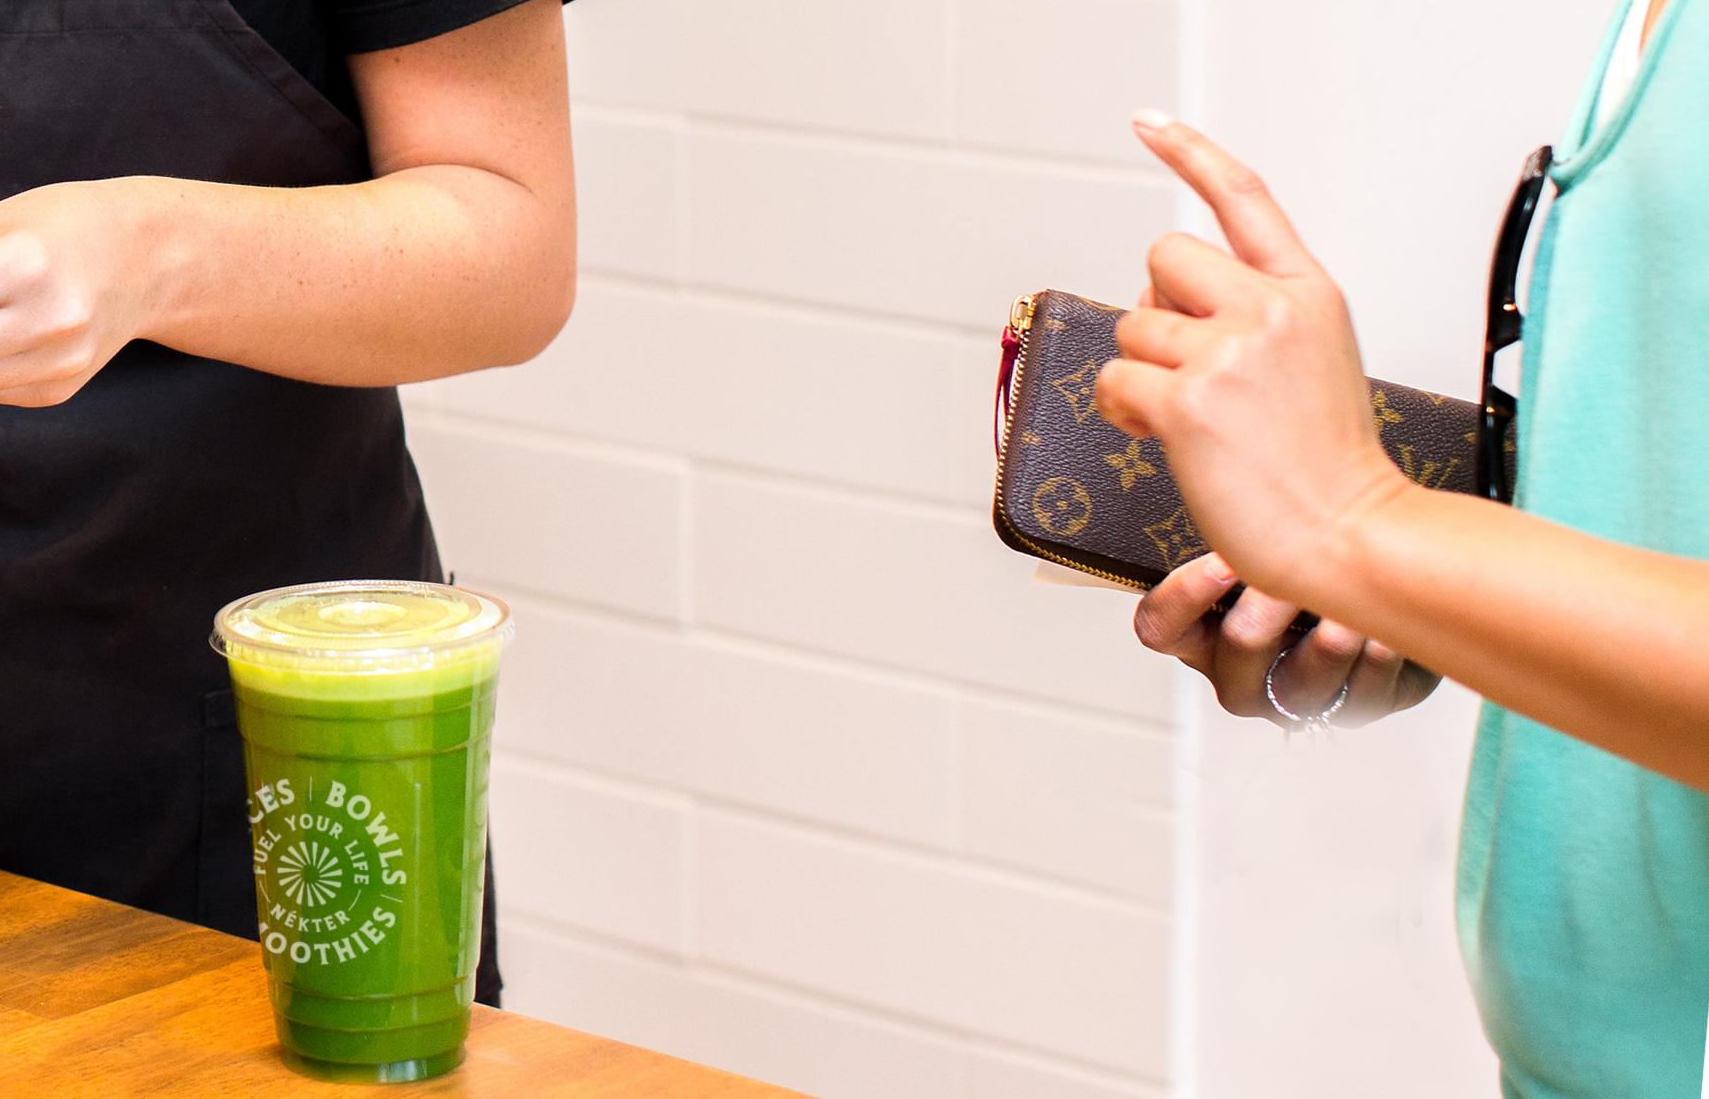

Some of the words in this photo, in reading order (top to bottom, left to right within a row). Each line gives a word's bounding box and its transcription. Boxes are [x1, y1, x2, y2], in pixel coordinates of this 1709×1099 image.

[246, 778, 295, 824] CES
[325, 780, 407, 885] BOWLS
[254, 829, 281, 875] FUEL
[284, 813, 344, 840] YOUR
[344, 840, 369, 885] LIFE
[259, 906, 396, 965] OOTHIES
[270, 903, 351, 933] NÉKTER
